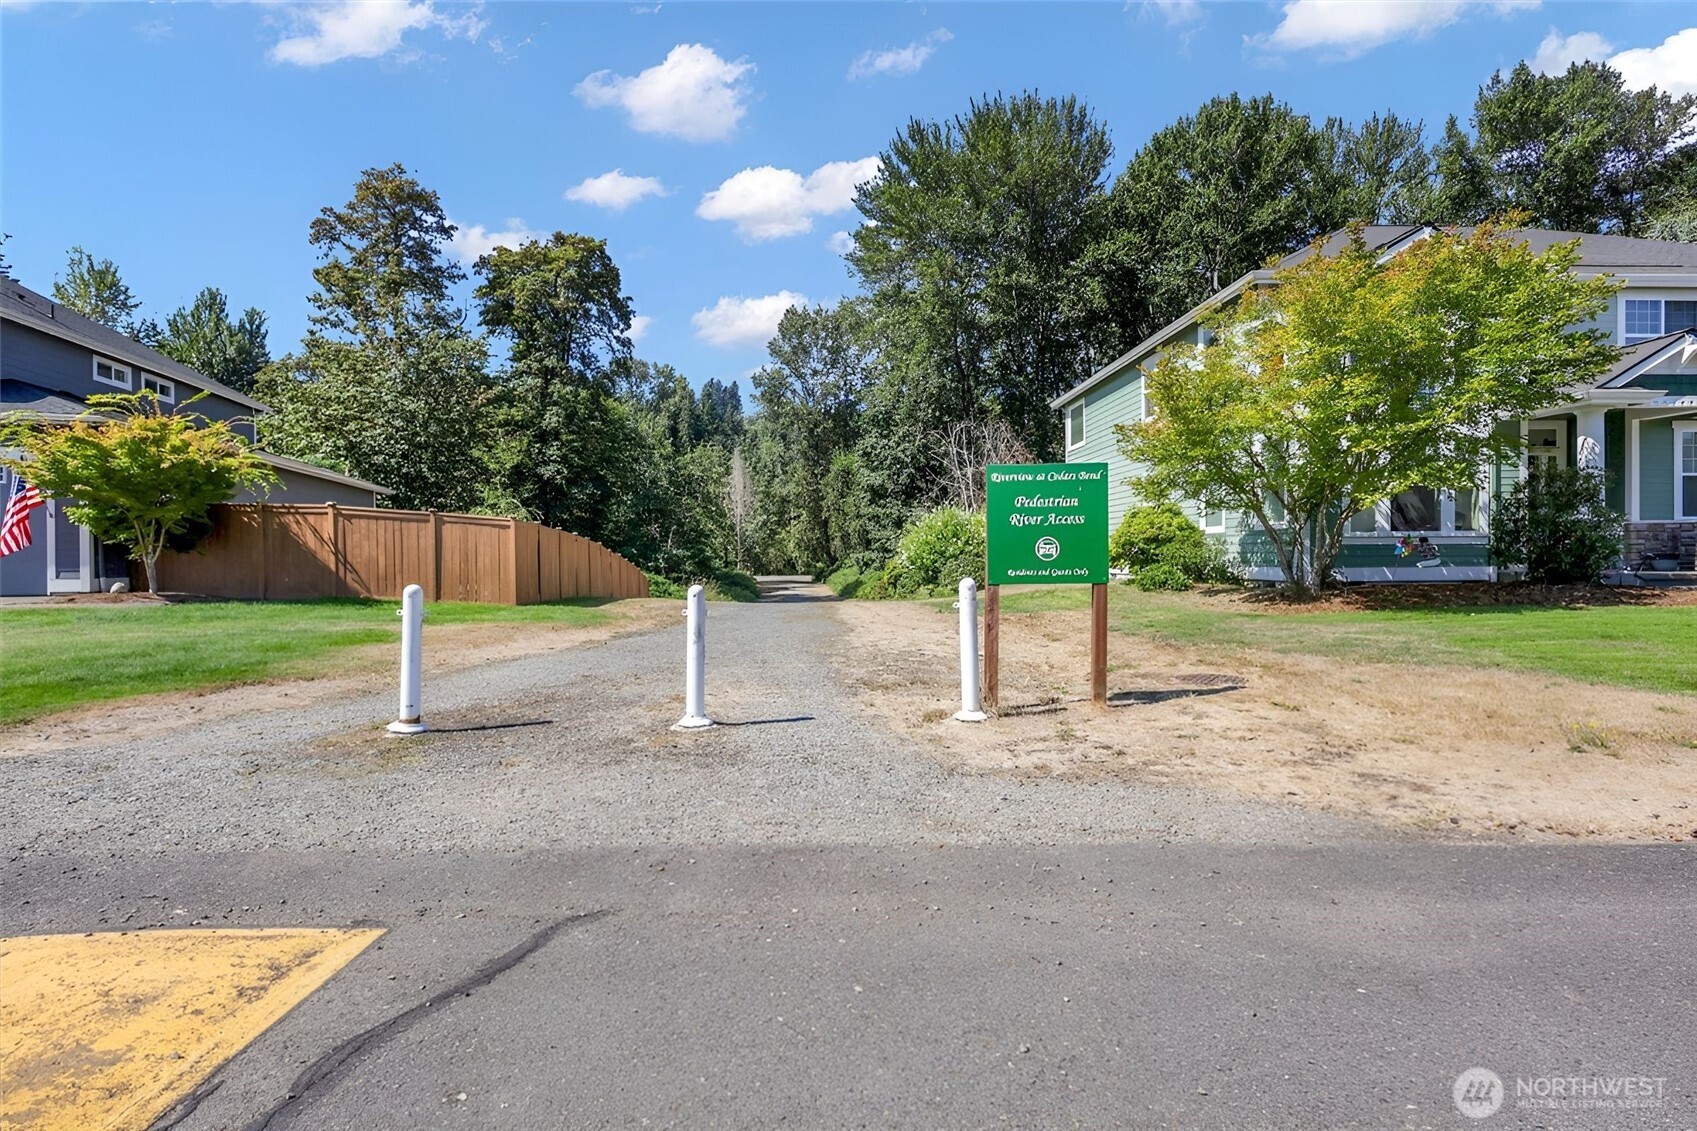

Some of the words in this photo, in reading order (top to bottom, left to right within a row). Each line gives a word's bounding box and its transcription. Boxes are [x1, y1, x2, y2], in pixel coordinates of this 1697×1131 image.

[1015, 494, 1079, 507] Pedestrian
[1009, 513, 1043, 526] River
[1044, 513, 1085, 526] Access
